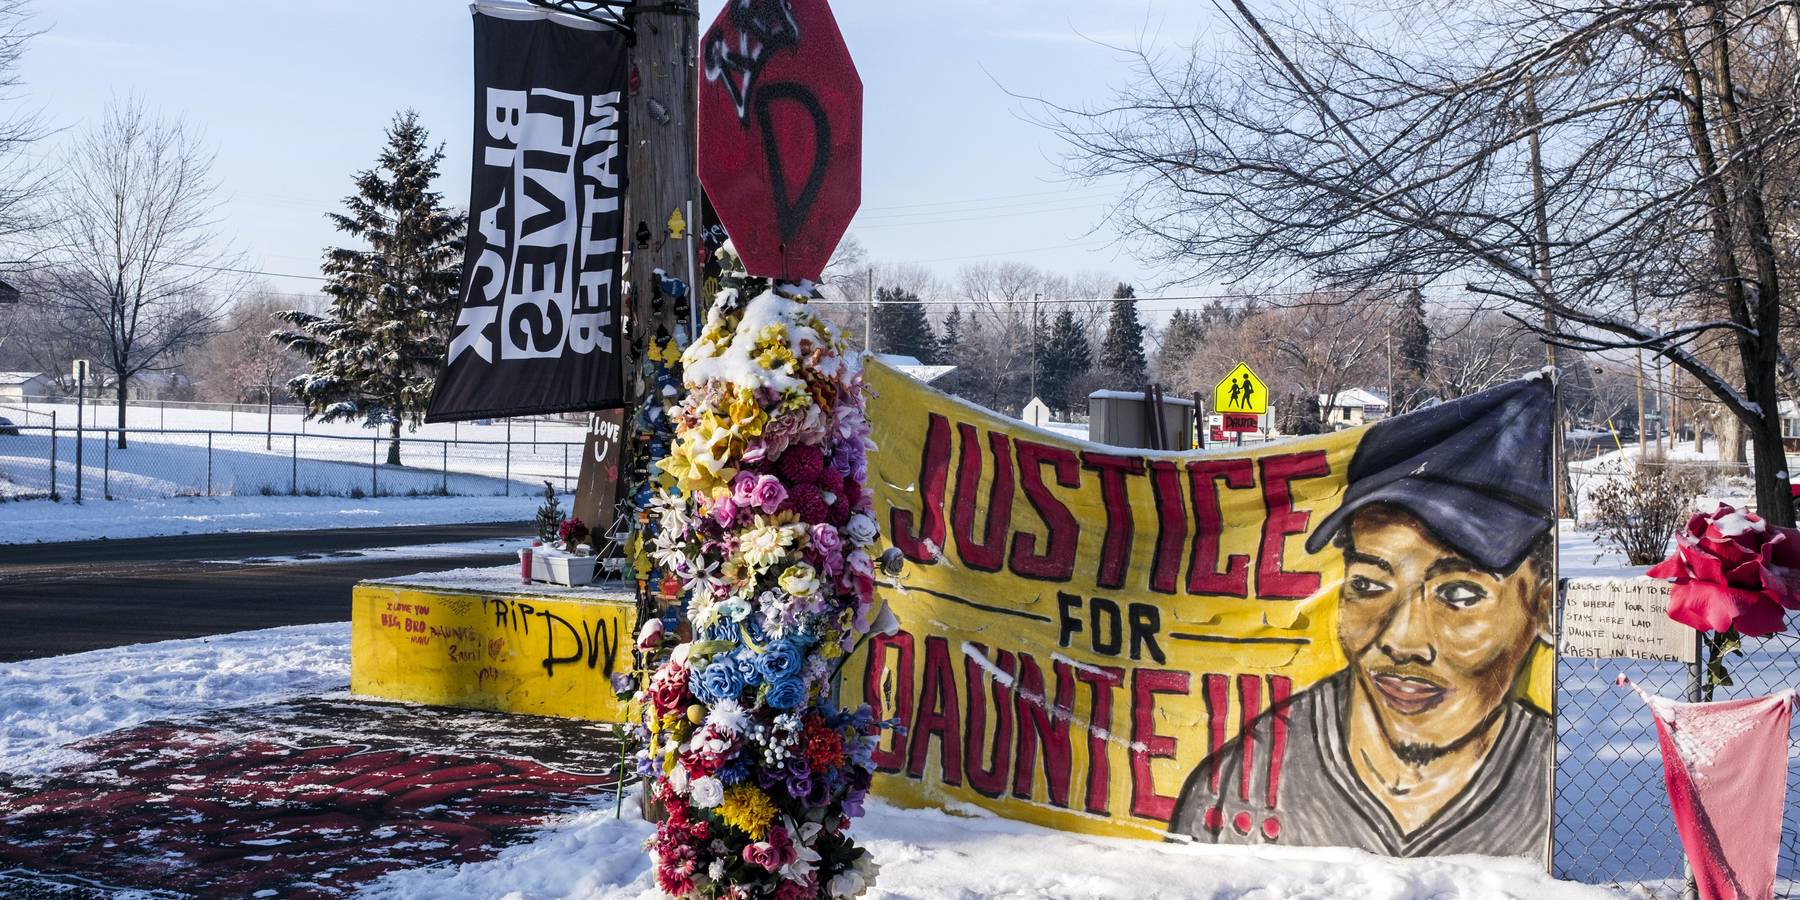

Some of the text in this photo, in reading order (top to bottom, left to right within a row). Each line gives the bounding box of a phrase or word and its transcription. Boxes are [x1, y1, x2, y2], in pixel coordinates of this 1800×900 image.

[754, 81, 832, 250] D
[587, 412, 620, 443] I LOVE
[595, 440, 608, 462] U
[890, 411, 1331, 600] JUSTICE
[1626, 585, 1643, 595] LAY
[1647, 586, 1657, 596] TO
[1660, 587, 1672, 596] RE
[393, 603, 412, 613] LOVE
[415, 605, 430, 615] YOU
[1567, 598, 1668, 615] IS WHERE YOUR SPIR
[381, 614, 426, 633] BIG BRO
[1056, 590, 1166, 664] FOR
[1566, 612, 1652, 629] STAYS HERE LAID
[536, 609, 618, 680] DW
[1568, 627, 1664, 646] DAUNTE WRIGHT
[1570, 645, 1679, 663] REST IN HEAVEN
